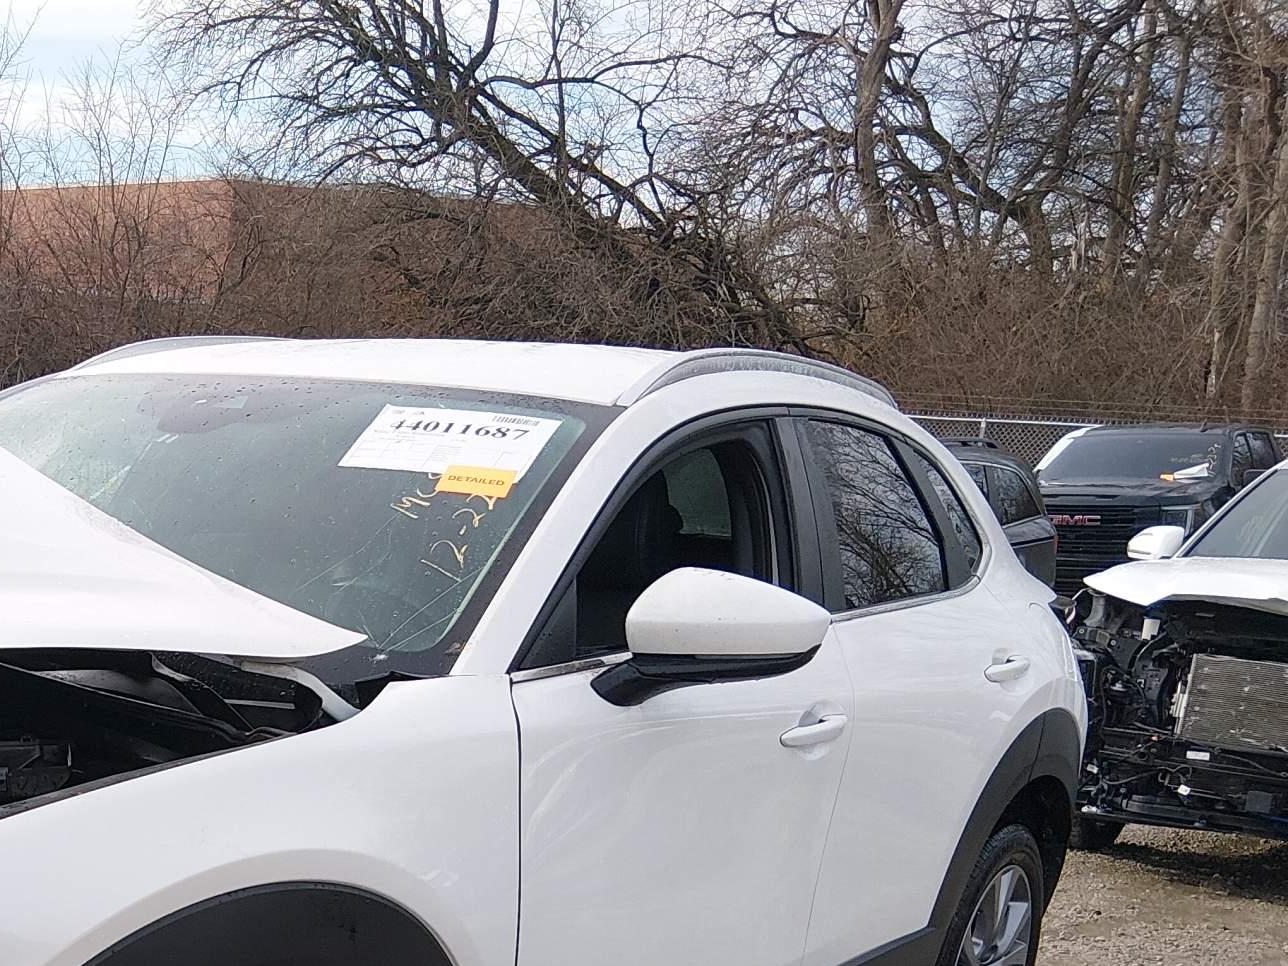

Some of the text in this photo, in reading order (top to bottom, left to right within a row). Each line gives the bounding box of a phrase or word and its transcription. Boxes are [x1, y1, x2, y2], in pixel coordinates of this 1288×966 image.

[390, 419, 530, 441] 44011687
[447, 475, 506, 487] DETAILED
[1047, 514, 1101, 526] GMC
